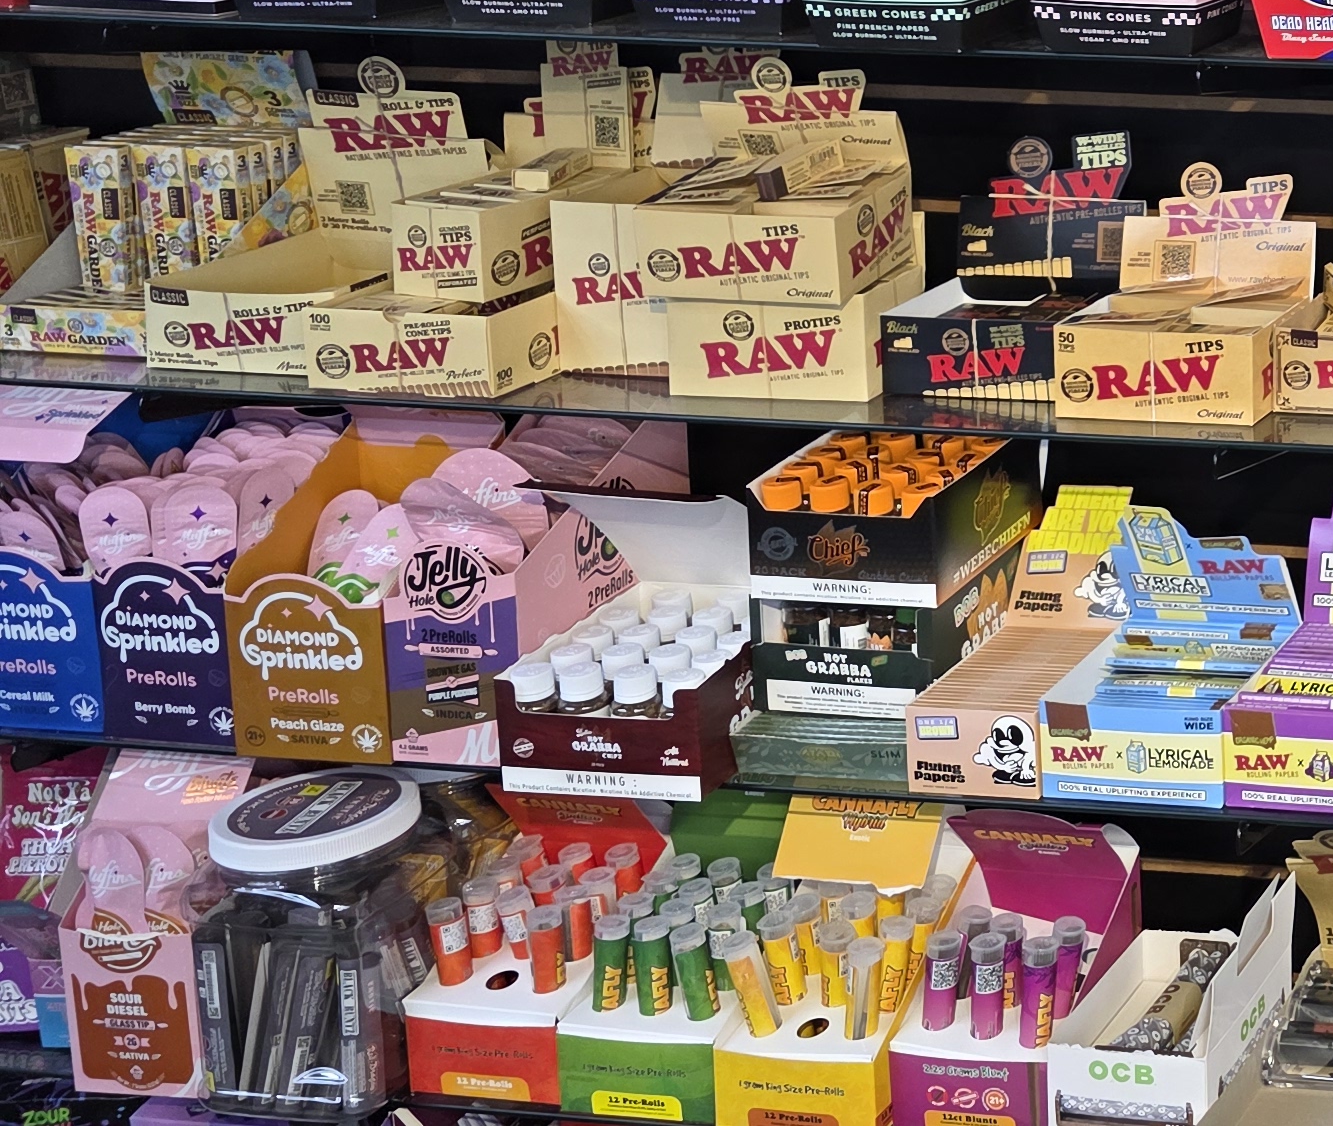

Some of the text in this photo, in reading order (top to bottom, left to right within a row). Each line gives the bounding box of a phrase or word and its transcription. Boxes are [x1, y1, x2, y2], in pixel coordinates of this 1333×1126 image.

[835, 9, 926, 20] GREEN CONES
[1271, 17, 1301, 31] DEAD
[784, 315, 841, 330] PROTIPS
[1186, 339, 1224, 353] TIPS
[699, 331, 842, 378] RAW
[807, 533, 870, 567] Chief
[409, 546, 487, 606] Jelly
[813, 582, 871, 594] WARNING:
[106, 624, 219, 663] Sprinkled
[126, 668, 197, 687] PreRolls
[270, 717, 345, 733] Peach Glaze
[1050, 746, 1105, 762] RAW
[1148, 748, 1214, 761] LYRICAL
[915, 760, 961, 774] Flying
[1148, 760, 1214, 770] LEMONADE
[914, 771, 966, 784] Papers
[1106, 788, 1149, 797] UPLIFTING
[1151, 791, 1203, 799] EXPERIENCE
[108, 993, 143, 1005] SOUR
[107, 1004, 148, 1017] DIESEL
[1089, 1061, 1154, 1085] OCB
